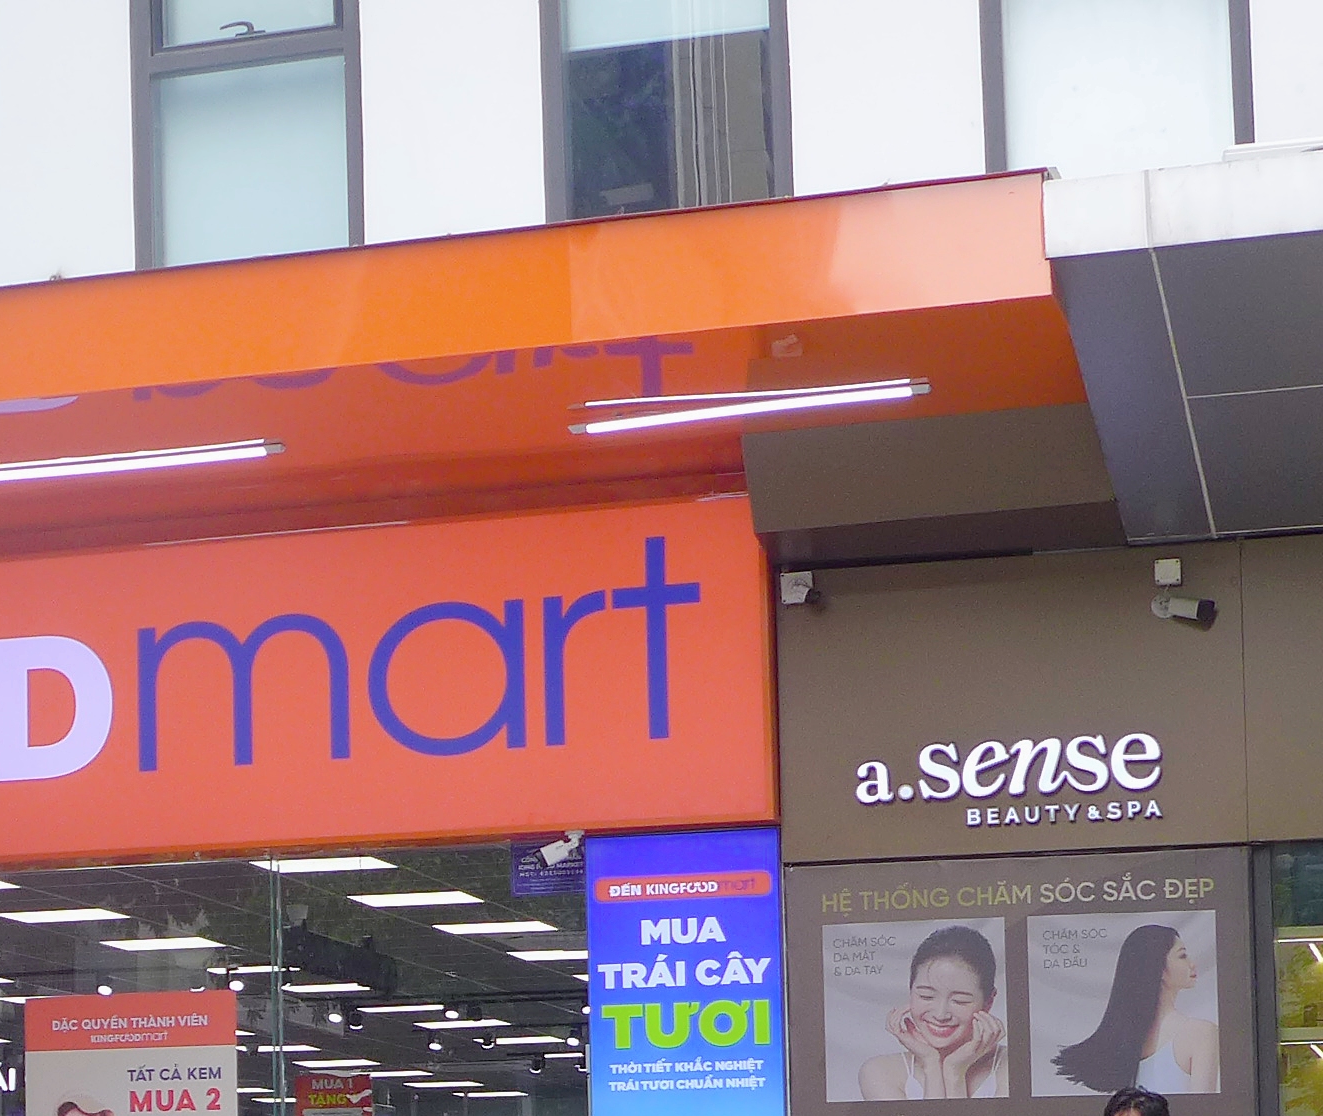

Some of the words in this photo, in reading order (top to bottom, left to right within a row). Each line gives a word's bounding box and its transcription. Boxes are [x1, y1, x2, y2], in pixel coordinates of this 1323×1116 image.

[609, 881, 643, 897] ĐẾN
[821, 889, 852, 917] HỆ
[858, 882, 950, 911] THỐNG
[956, 880, 1032, 907] CHĂM
[1039, 877, 1095, 904] SÓC
[1102, 872, 1156, 902] SẮC
[1163, 877, 1215, 904] ĐẸP
[641, 916, 726, 946] MUA
[597, 954, 686, 989] TRÁI
[695, 951, 772, 986] CÂY
[863, 964, 884, 975] TAY
[51, 1017, 79, 1034] ĐẶC
[130, 1014, 176, 1030] THÀNH
[178, 1011, 208, 1027] VIÊN
[600, 998, 771, 1050] TƯƠI
[127, 1064, 155, 1082] TẤT
[159, 1063, 182, 1081] CẢ
[187, 1067, 222, 1080] KEM
[609, 1061, 642, 1075] THỜI
[644, 1058, 673, 1073] TIẾT
[675, 1056, 713, 1073] KHẮC
[715, 1057, 765, 1074] NGHIỆT
[311, 1078, 344, 1090] MUA
[608, 1078, 640, 1092] TRÁI
[726, 1075, 766, 1091] NHIỆT
[129, 1087, 197, 1113] MUA
[206, 1086, 222, 1111] 2
